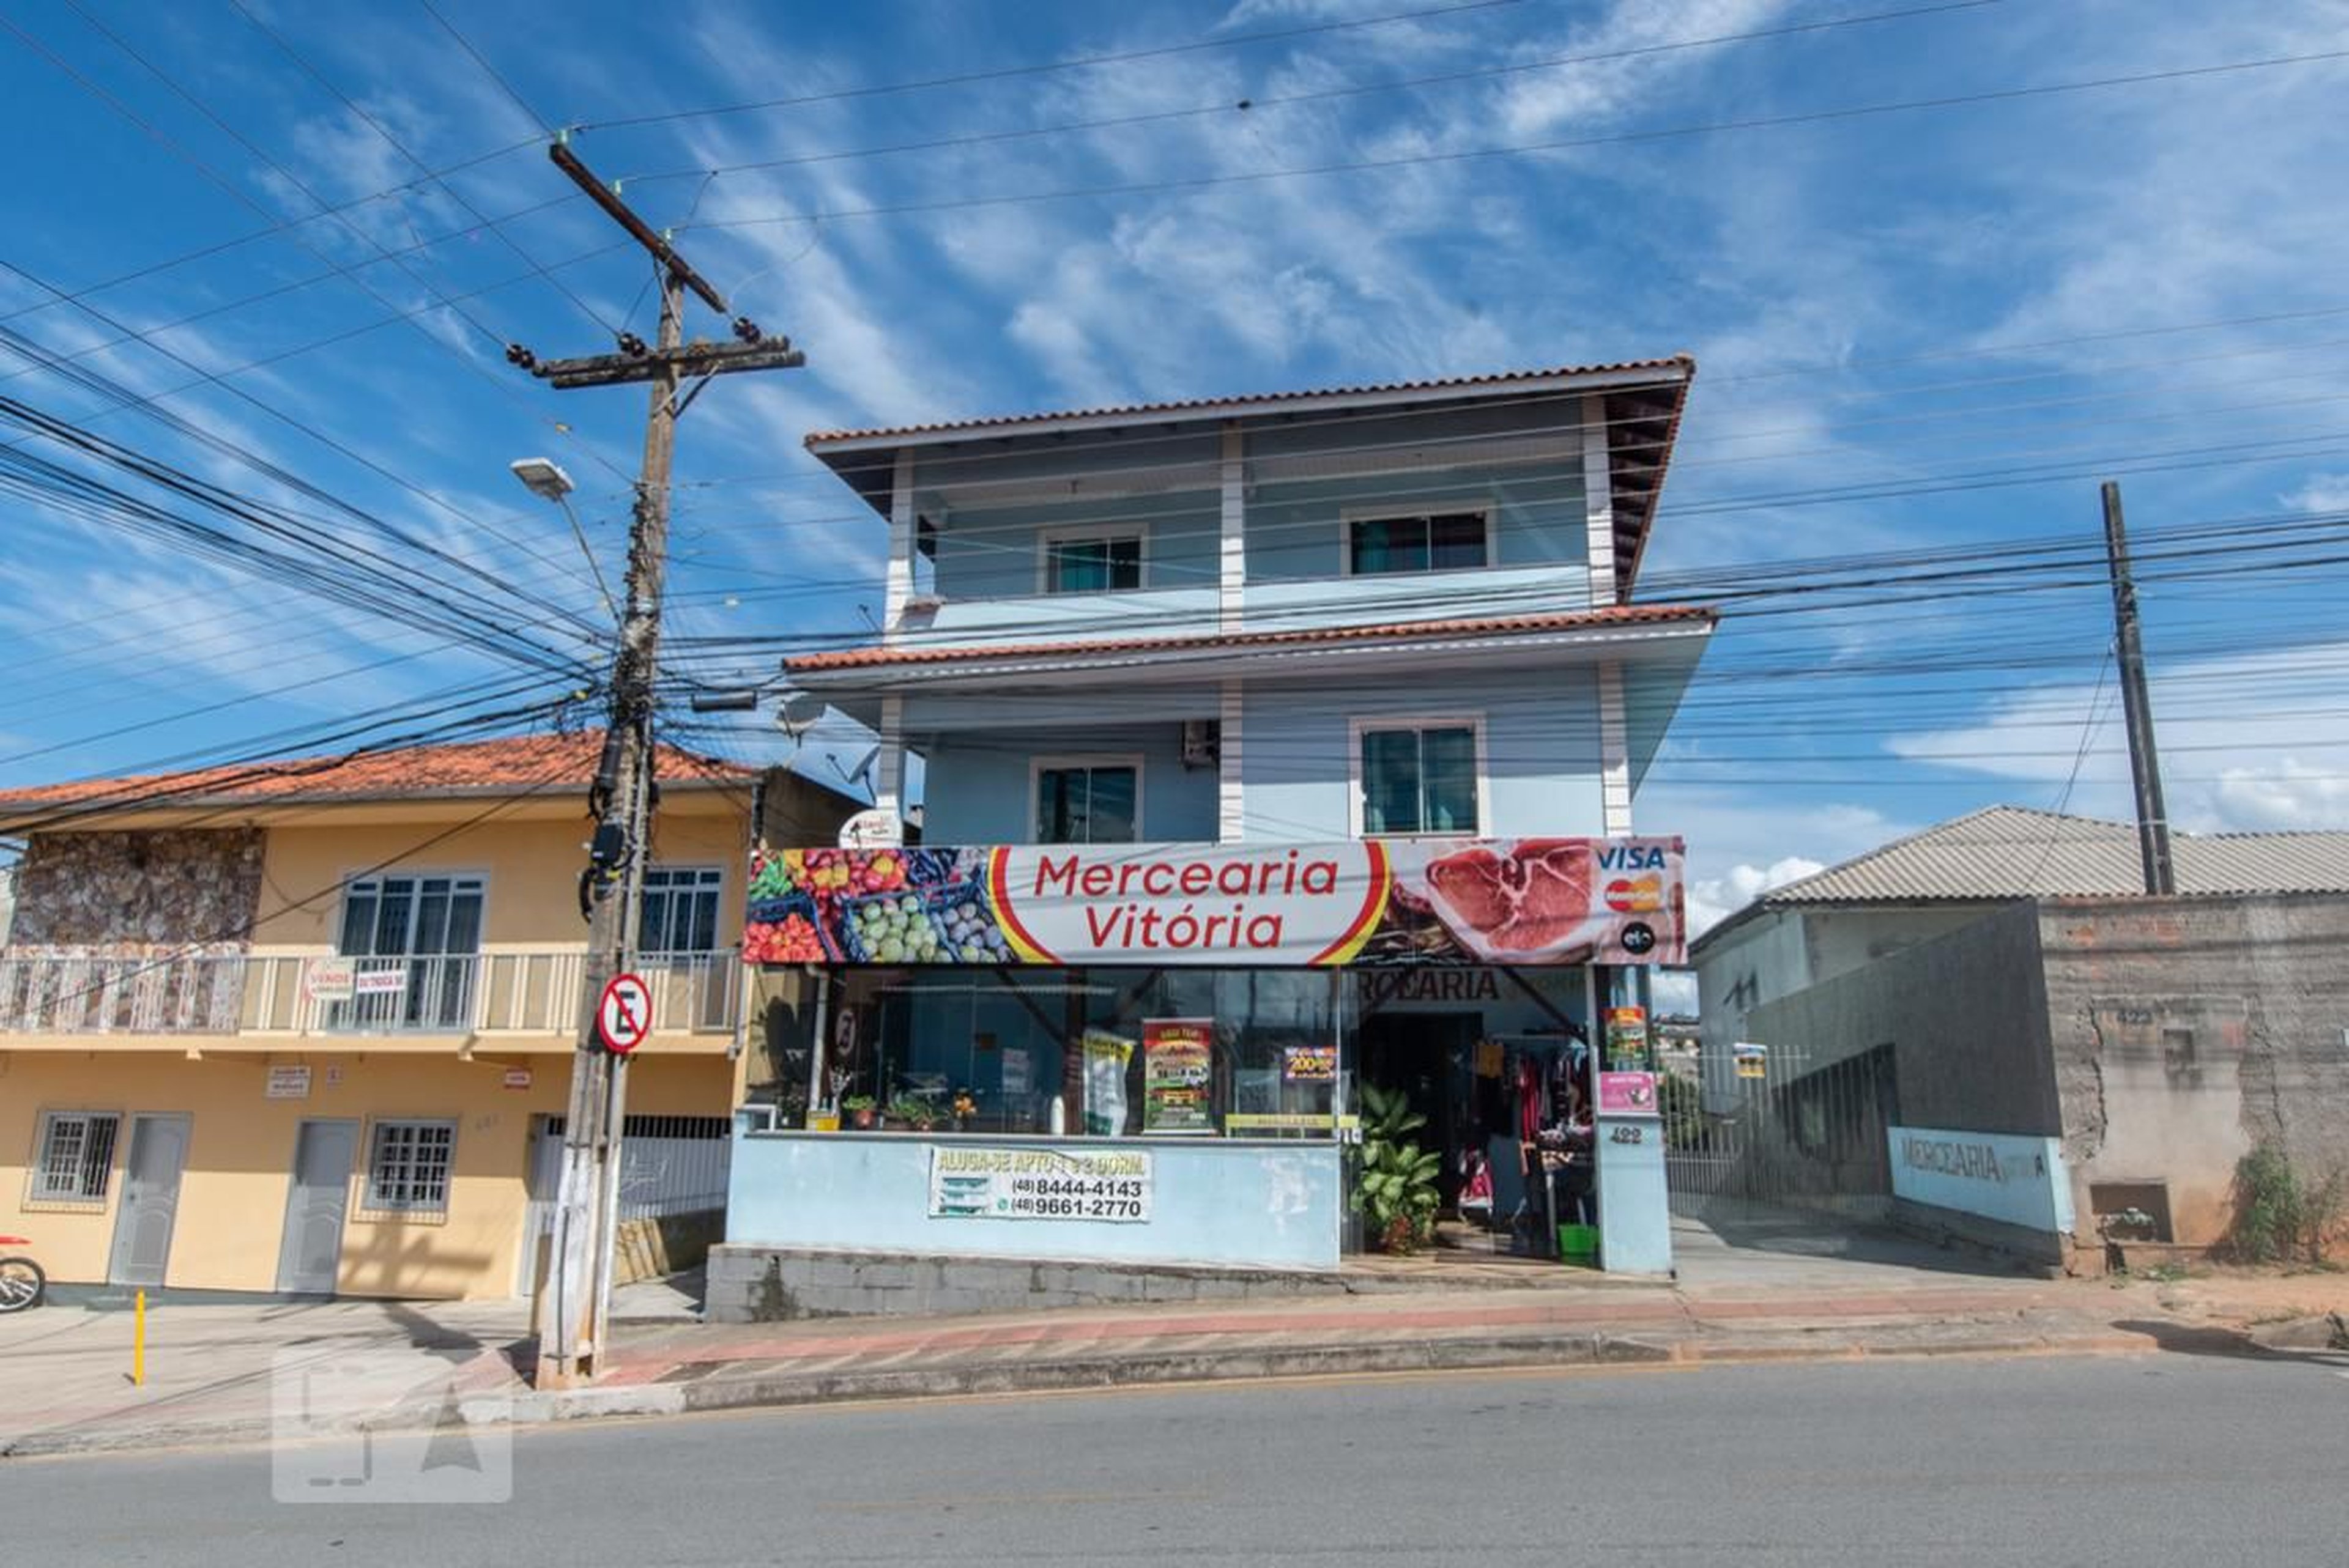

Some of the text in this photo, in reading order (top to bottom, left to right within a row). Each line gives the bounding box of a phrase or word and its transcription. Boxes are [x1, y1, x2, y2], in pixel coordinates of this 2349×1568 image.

[1597, 846, 1666, 870] VISA
[1034, 849, 1338, 897] Mercearia
[1086, 903, 1285, 949] Vitória
[1037, 1179, 1142, 1197] 8444-4143
[1036, 1199, 1141, 1217] 9661-2770
